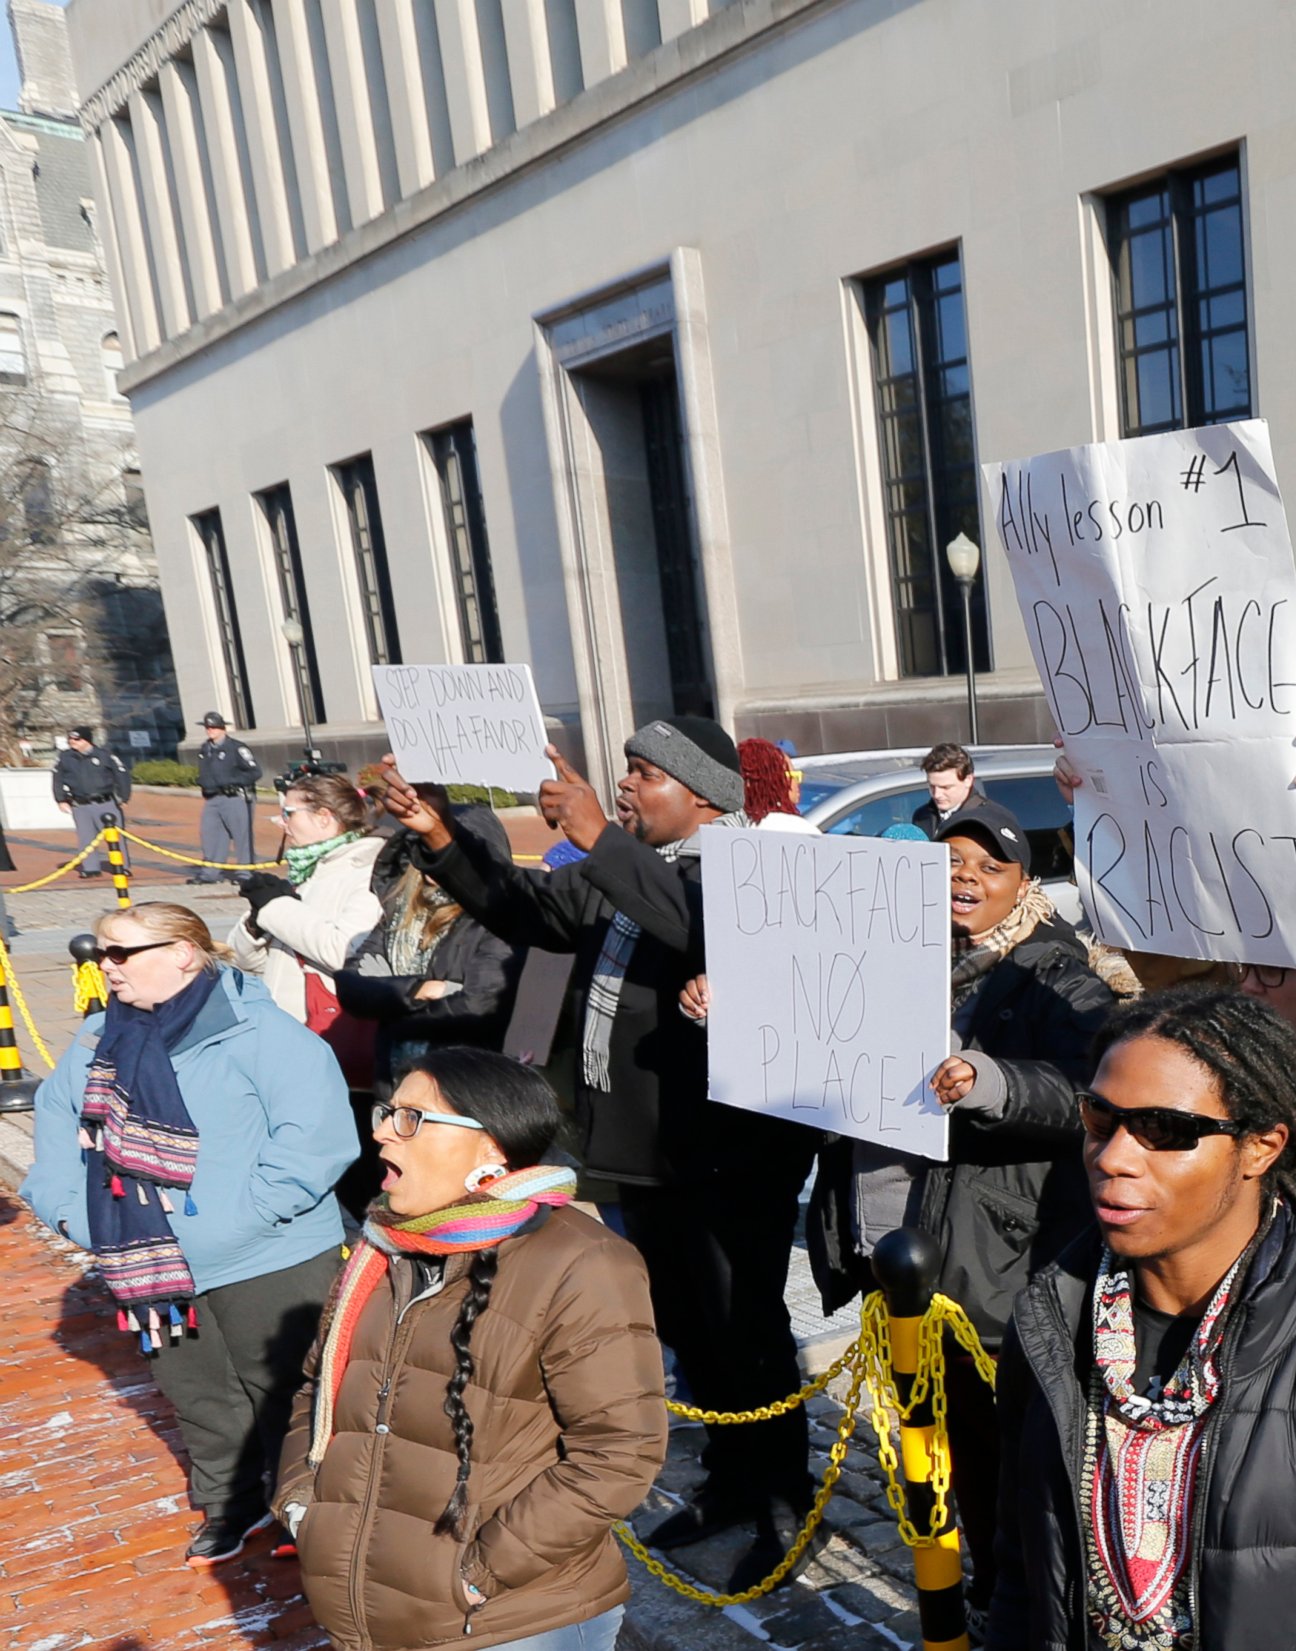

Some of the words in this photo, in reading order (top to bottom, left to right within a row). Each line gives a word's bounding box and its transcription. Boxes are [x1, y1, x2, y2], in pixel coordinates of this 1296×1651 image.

[1001, 470, 1060, 587] Ally
[1061, 473, 1163, 546] lesson
[1180, 451, 1267, 532] #1
[386, 667, 420, 709] STEP
[428, 669, 484, 707] DOWN
[488, 668, 525, 702] AND
[1033, 577, 1296, 740] BLACKFACE
[391, 717, 418, 750] DO
[417, 710, 462, 777] VA
[456, 715, 471, 754] A
[731, 838, 942, 947] BLACKFACE
